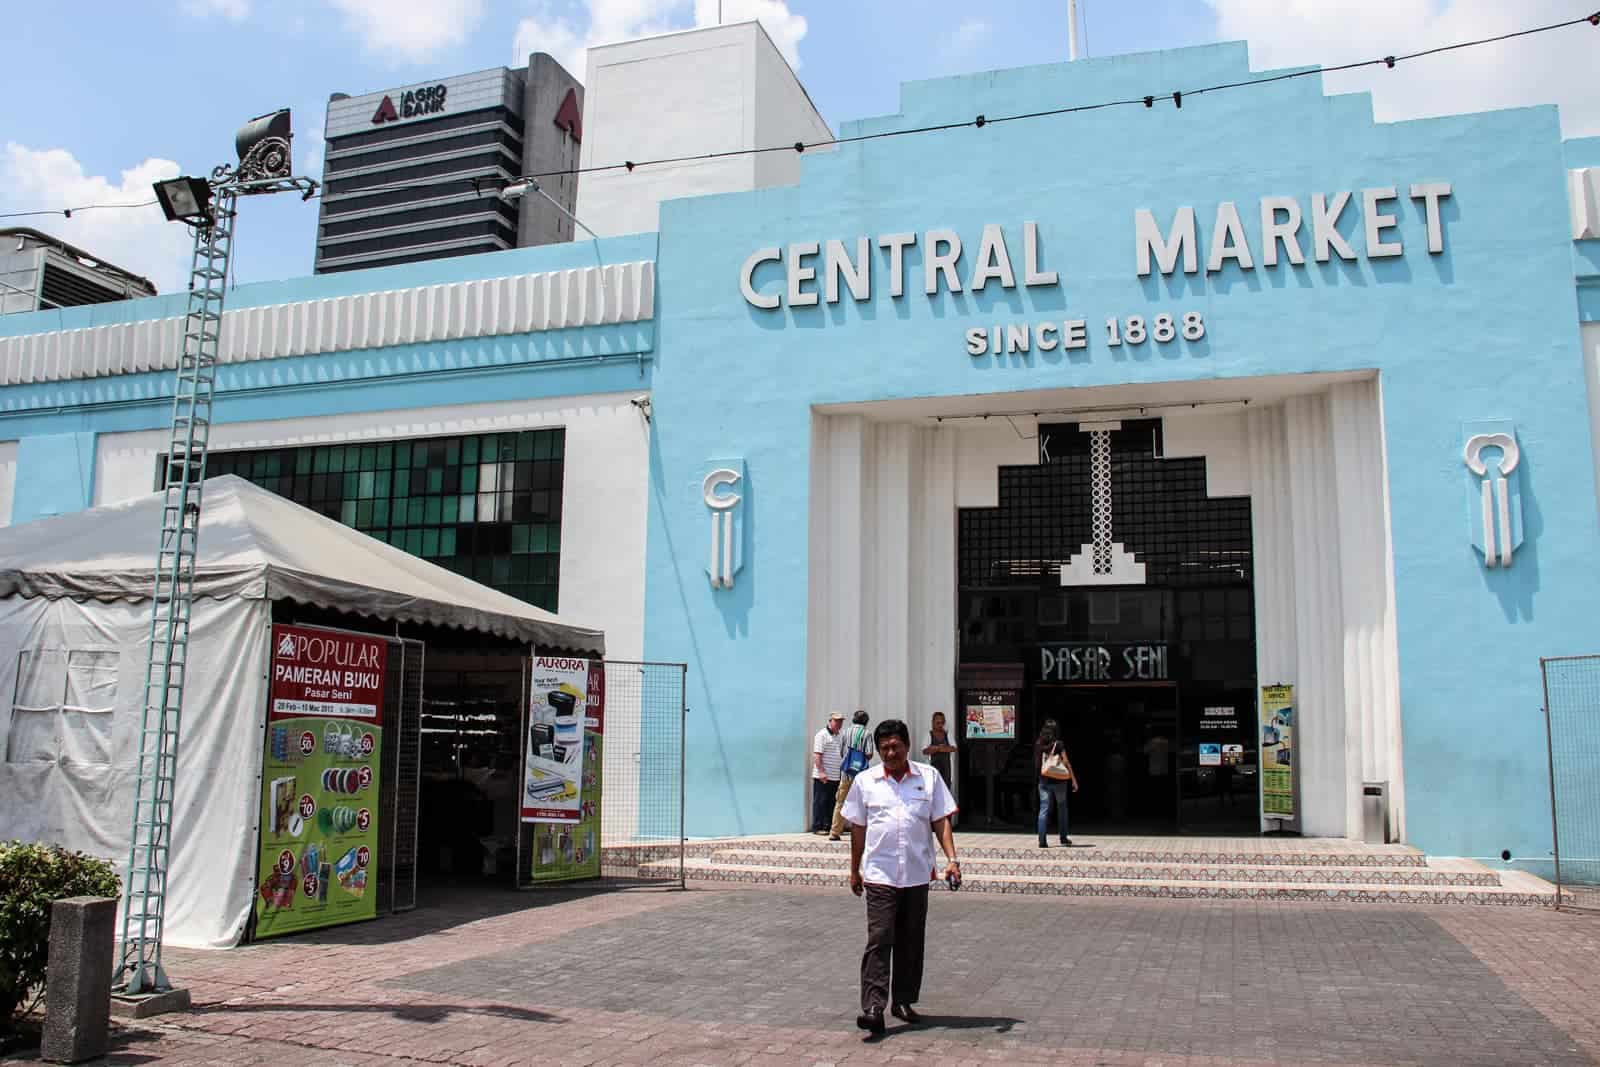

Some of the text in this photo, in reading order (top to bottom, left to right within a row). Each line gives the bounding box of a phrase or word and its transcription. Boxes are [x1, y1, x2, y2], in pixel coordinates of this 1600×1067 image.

[404, 84, 447, 104] AGRO
[403, 97, 445, 118] BANK
[738, 182, 1453, 310] CENTRAL MARKET
[965, 311, 1206, 357] SINCE 1888
[297, 635, 380, 669] POPULAR
[536, 657, 585, 671] AURORA
[1041, 646, 1168, 680] PASAR SENI
[275, 664, 379, 689] PAMERAN BUKU
[305, 687, 353, 700] Pasar Seni
[286, 703, 297, 711] Feb
[302, 804, 313, 813] 10
